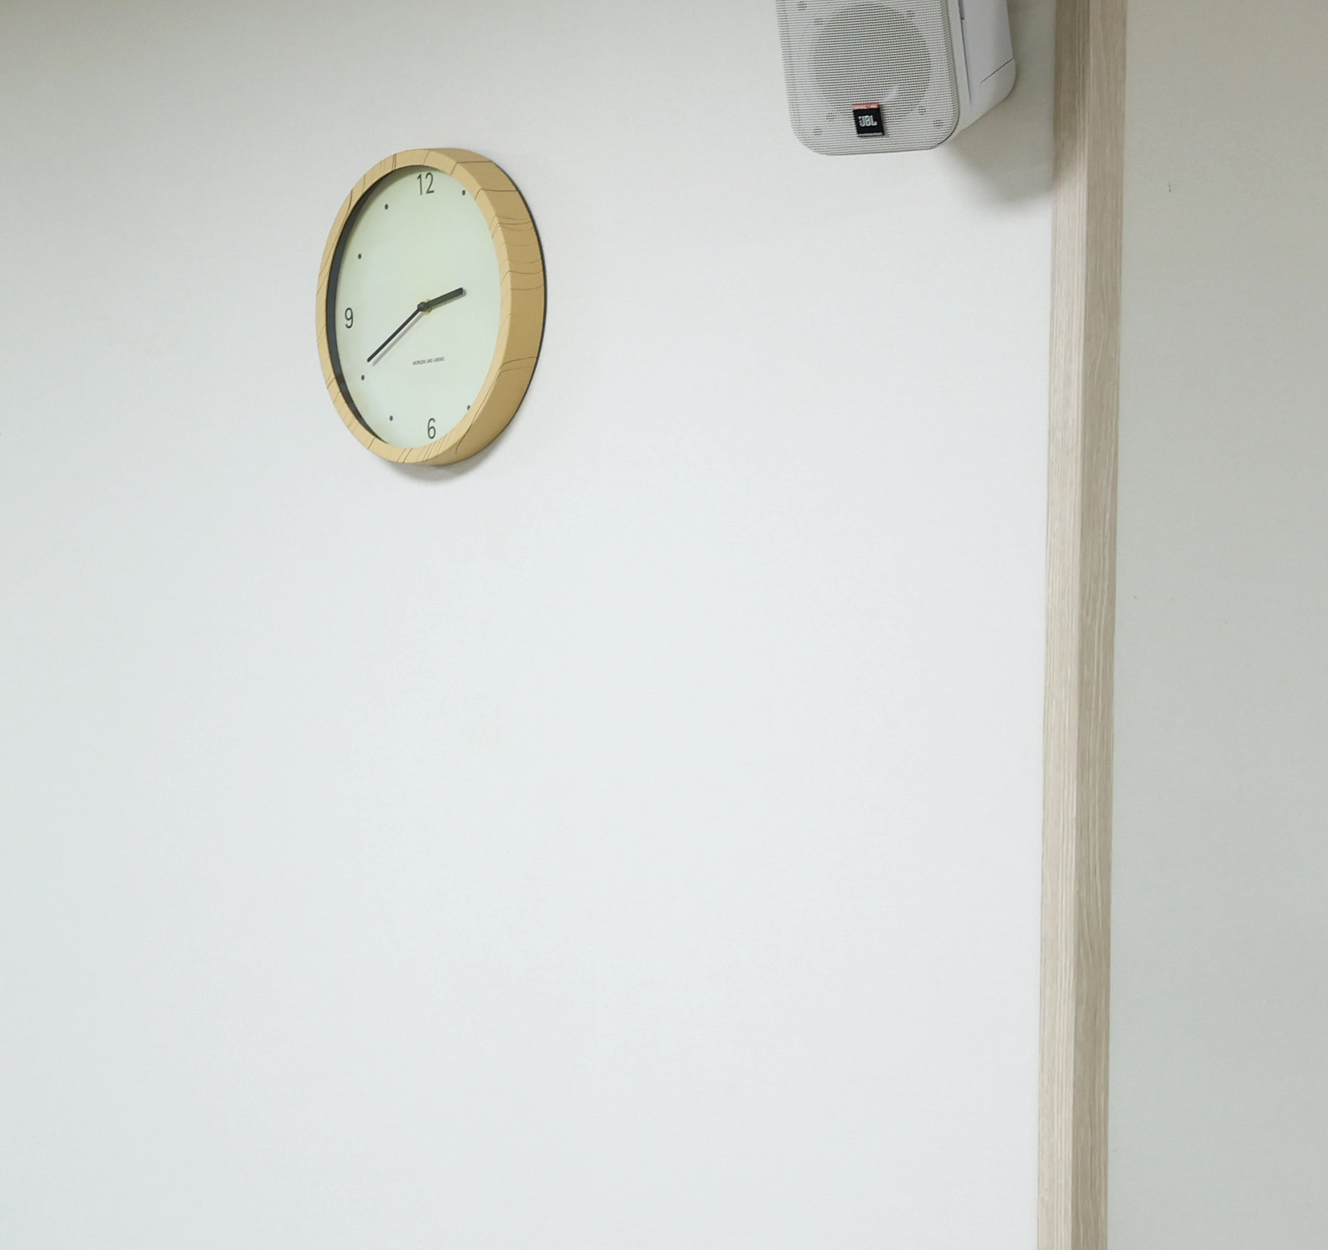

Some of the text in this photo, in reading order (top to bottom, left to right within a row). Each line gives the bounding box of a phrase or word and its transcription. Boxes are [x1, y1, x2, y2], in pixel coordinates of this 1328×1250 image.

[858, 115, 878, 127] JBL
[416, 172, 435, 196] 12
[344, 307, 354, 329] 9
[427, 417, 437, 440] 6
